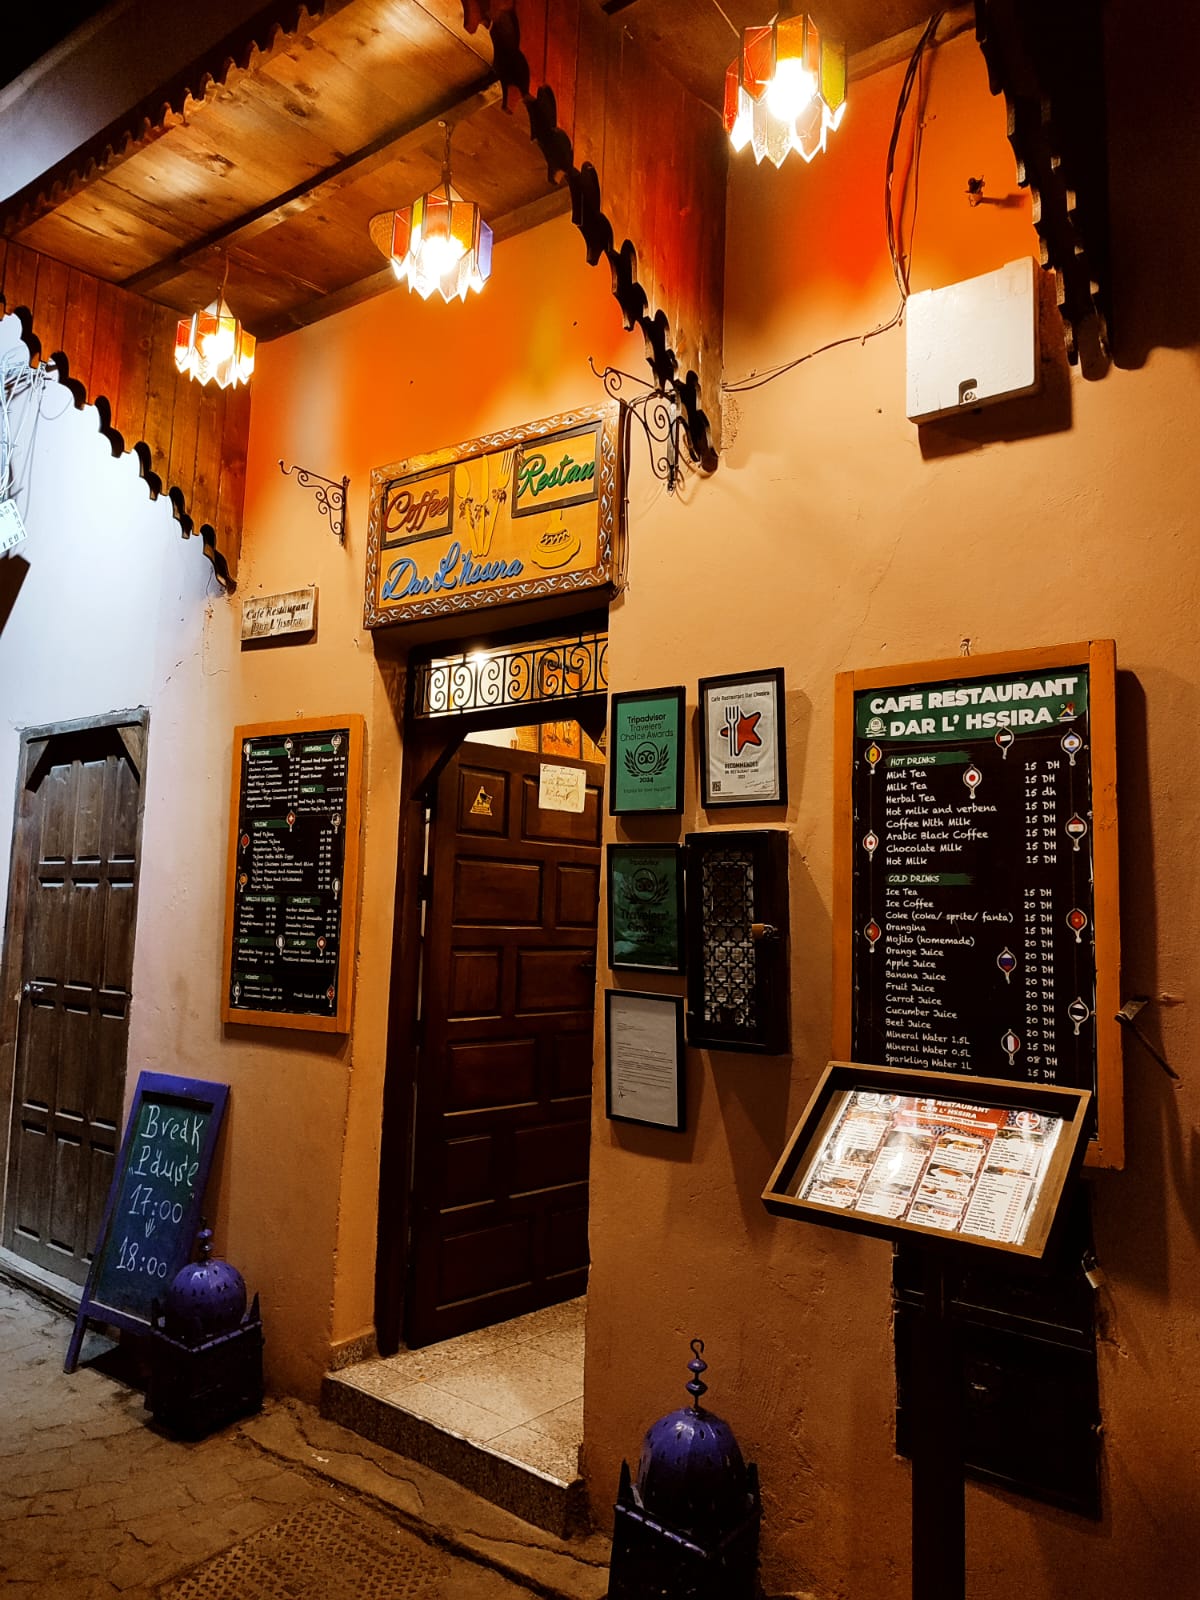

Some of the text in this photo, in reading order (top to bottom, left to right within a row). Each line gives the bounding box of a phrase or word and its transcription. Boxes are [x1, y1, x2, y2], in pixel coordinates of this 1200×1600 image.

[383, 489, 450, 534] Coffee
[382, 557, 433, 601] Dar
[870, 678, 1078, 715] CAFE RESTAURANT
[627, 713, 667, 725] Tripadvisor
[890, 707, 1053, 737] DAR L' HSSIRA
[620, 729, 674, 742] Choice Awards
[907, 756, 936, 764] DRINKS
[1025, 761, 1059, 770] 15 DH
[887, 771, 906, 779] Mint
[1042, 774, 1055, 782] DH
[887, 783, 907, 791] Milk
[1026, 787, 1056, 797] 15 dh
[886, 794, 914, 803] Herbal
[933, 805, 952, 813] and
[957, 803, 996, 812] verbena
[1026, 801, 1055, 810] 15 DH
[886, 818, 970, 829] Coffee With Milk
[1026, 815, 1055, 823] 15 DH
[887, 830, 988, 840] Arabic Black Coffee
[1026, 828, 1056, 837] 15 DH
[887, 843, 962, 852] Chocolate Milk
[1027, 842, 1056, 850] 15 DH
[887, 857, 901, 865] Hot
[1043, 855, 1056, 863] DH
[903, 899, 933, 908] Coffee
[912, 911, 942, 920] (coka/
[947, 912, 978, 923] sprite/
[982, 913, 1013, 922] fanta)
[1025, 914, 1035, 922] 15
[886, 923, 925, 933] Orangina
[886, 935, 974, 946] Mojito (homemade)
[886, 948, 916, 957] Orange
[886, 959, 936, 969] Apple Juice
[886, 971, 918, 979] Banana
[912, 984, 935, 992] Juice
[886, 994, 941, 1005] Carrot Juice
[886, 1007, 957, 1018] Cucumber Juice
[886, 1018, 931, 1028] Beet Juice
[886, 1031, 969, 1044] Mineral Water 1.5L
[886, 1043, 970, 1057] Mineral Water 0.5L
[886, 1054, 928, 1068] Sparkling
[932, 1059, 957, 1067] Water
[1046, 1057, 1057, 1065] DH
[1044, 1070, 1055, 1078] DH
[936, 1099, 990, 1114] RESTAURANT
[947, 1109, 977, 1119] HSSIRA
[946, 1193, 967, 1202] SALAD
[128, 1183, 184, 1224] 17:00
[115, 1236, 167, 1279] 18:00
